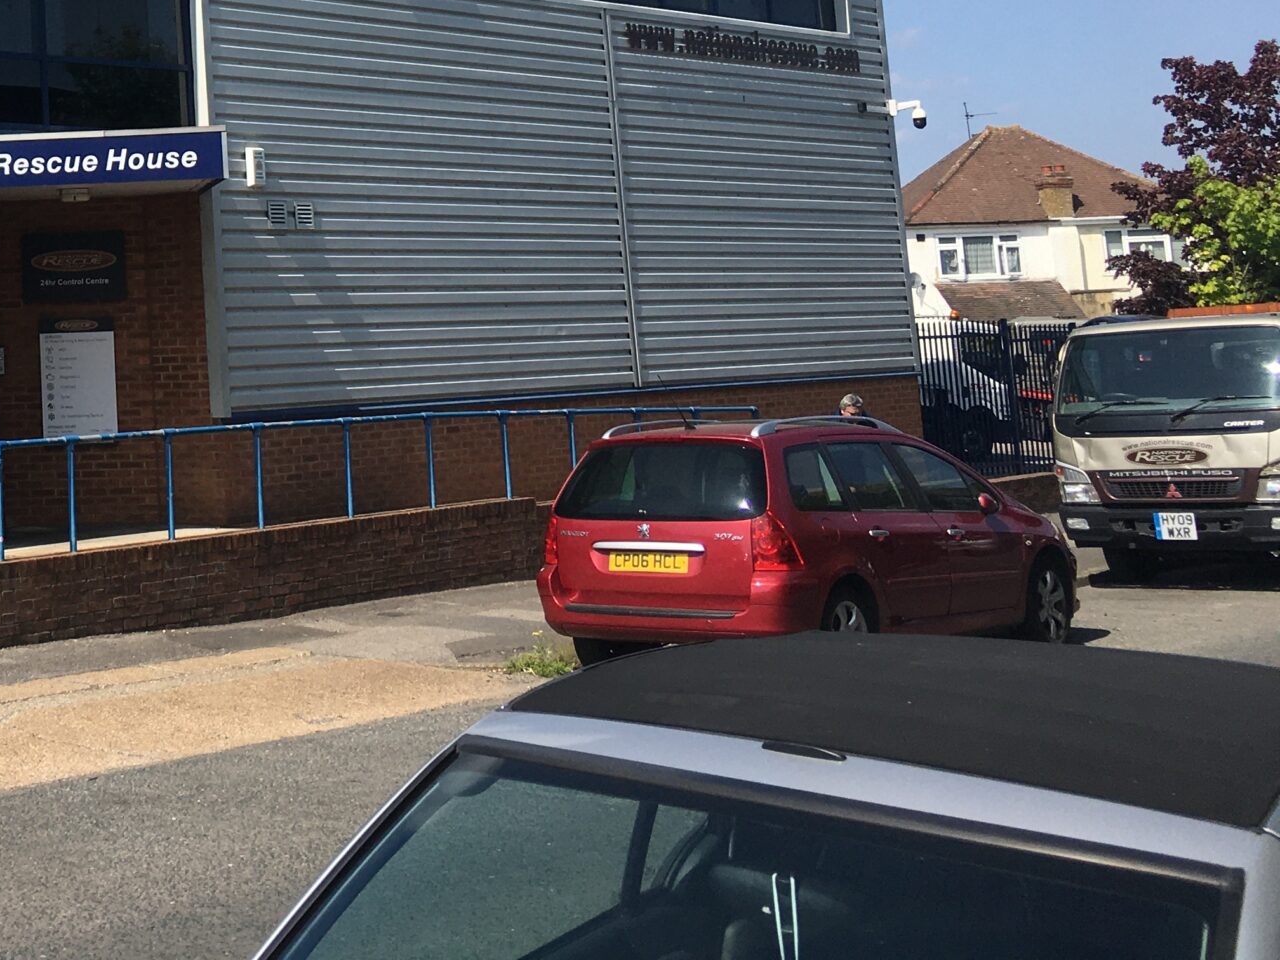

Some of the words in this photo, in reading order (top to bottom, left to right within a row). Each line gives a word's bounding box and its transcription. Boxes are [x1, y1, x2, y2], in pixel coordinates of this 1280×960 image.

[105, 148, 198, 172] House
[57, 278, 84, 286] Control
[85, 277, 109, 285] Centre
[1135, 451, 1196, 462] RESCUE
[1161, 514, 1193, 525] HY09
[1167, 527, 1191, 538] WXR
[614, 553, 649, 568] CP06
[653, 554, 681, 569] HCL
